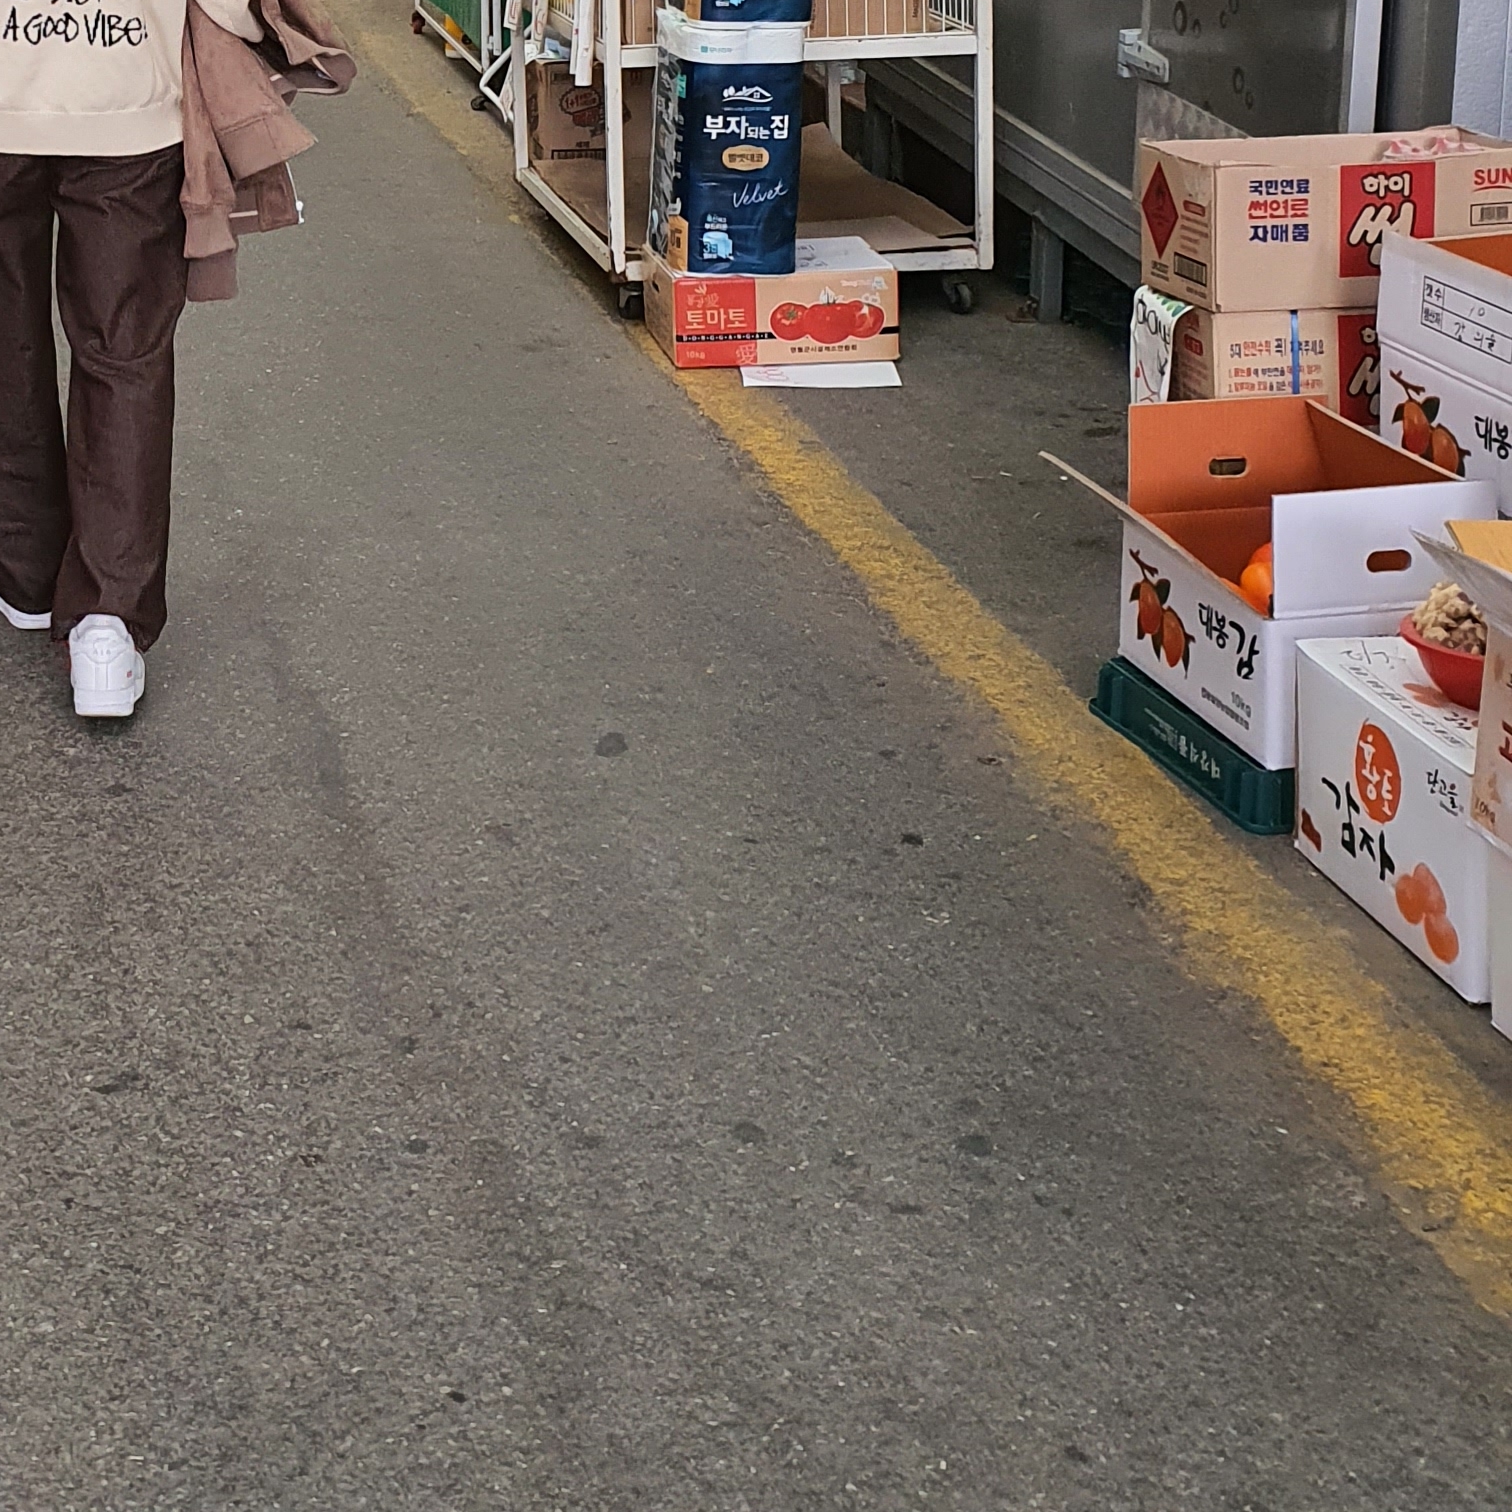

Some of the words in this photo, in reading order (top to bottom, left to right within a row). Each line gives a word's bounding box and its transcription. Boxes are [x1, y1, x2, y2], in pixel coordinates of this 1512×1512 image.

[3, 5, 19, 43] A
[1248, 178, 1310, 197] 국민연료
[1361, 172, 1412, 198] 하이
[1473, 168, 1512, 187] SUN
[732, 178, 789, 209] Velvet
[1247, 197, 1309, 220] 썬연료
[1248, 222, 1309, 243] 자매품
[685, 308, 748, 330] 토마토
[1322, 775, 1397, 882] 감자
